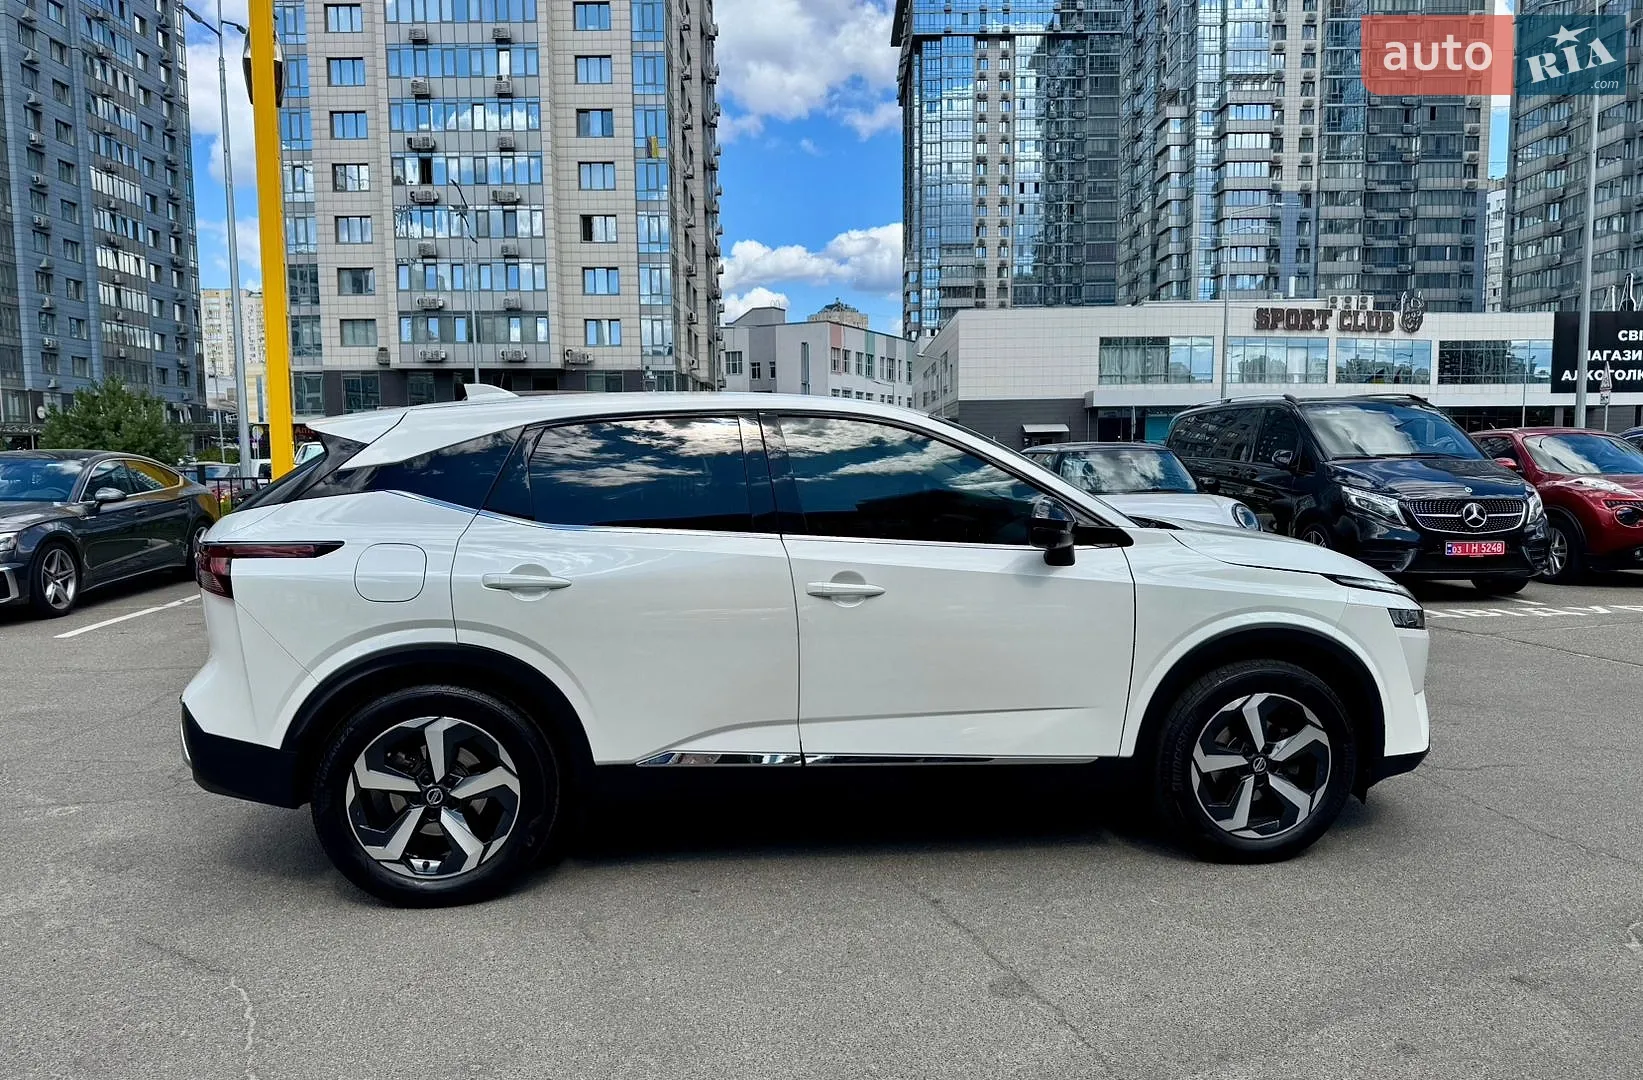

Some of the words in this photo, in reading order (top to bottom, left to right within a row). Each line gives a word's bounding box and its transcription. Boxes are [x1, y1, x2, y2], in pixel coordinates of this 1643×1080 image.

[1255, 307, 1332, 331] SPORT
[1337, 309, 1395, 332] CLUB
[1481, 542, 1502, 553] 5248
